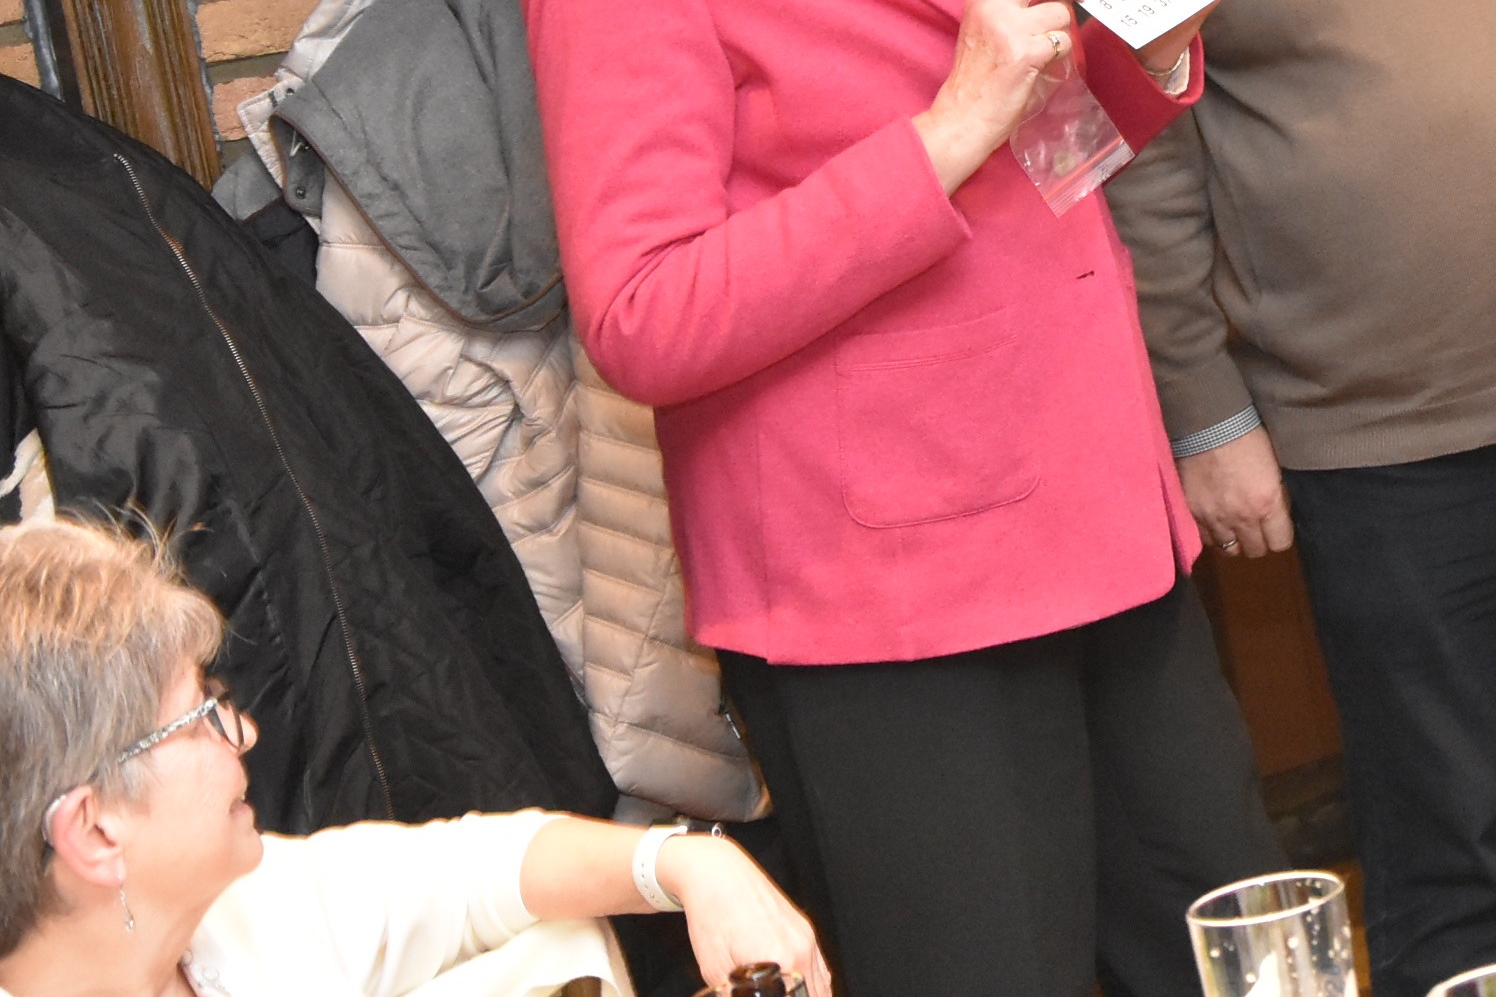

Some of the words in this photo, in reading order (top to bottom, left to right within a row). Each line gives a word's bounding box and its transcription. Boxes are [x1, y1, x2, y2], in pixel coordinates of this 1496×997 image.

[1100, 0, 1112, 9] 8
[1121, 15, 1138, 27] 15
[1138, 4, 1154, 17] 19
